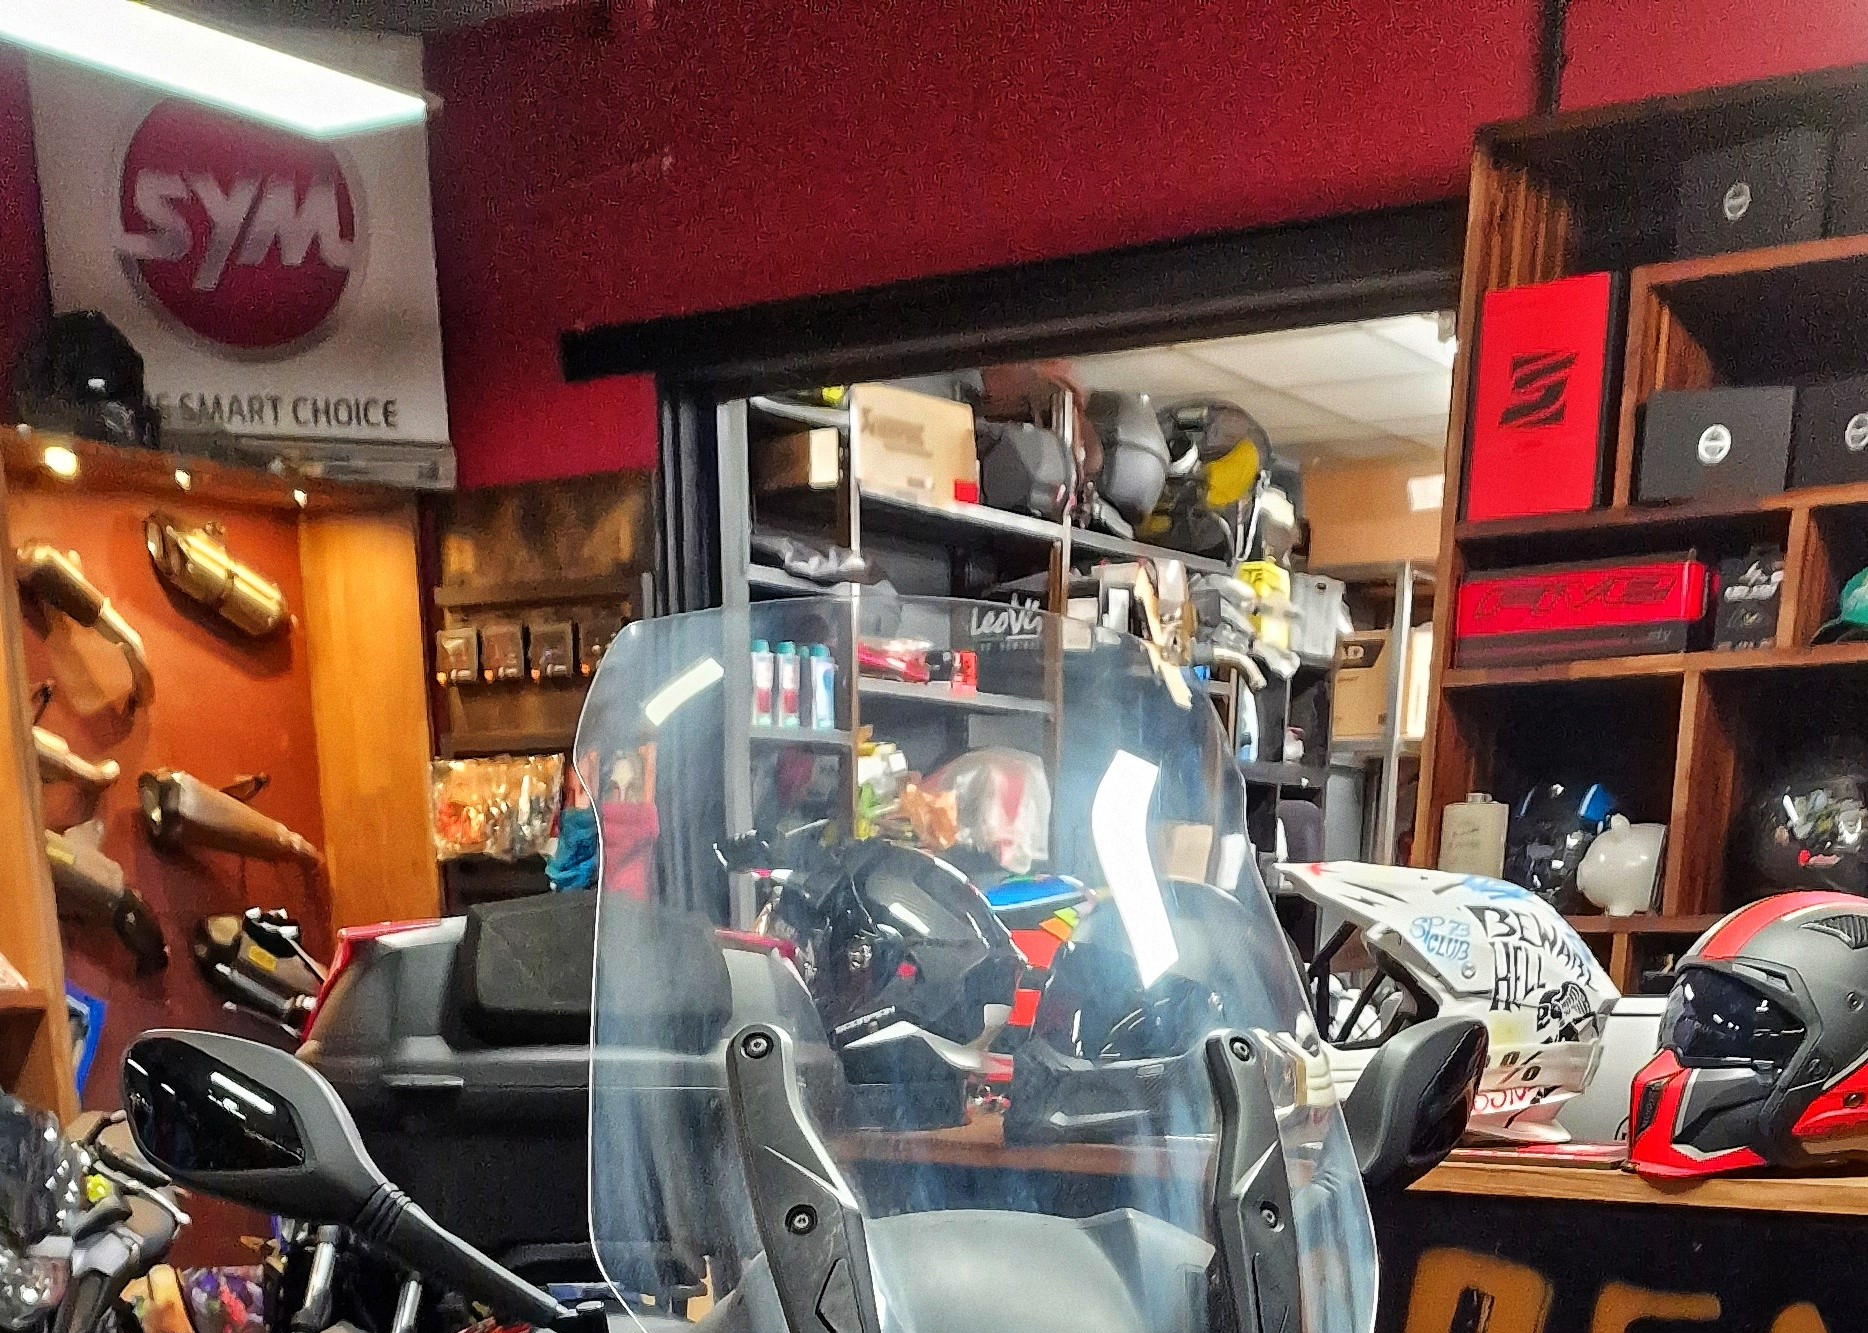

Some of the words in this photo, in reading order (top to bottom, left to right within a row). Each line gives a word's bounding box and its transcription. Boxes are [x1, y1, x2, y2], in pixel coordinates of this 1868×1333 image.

[113, 169, 357, 292] SYM
[178, 391, 281, 427] SMART
[291, 397, 398, 428] CHOICE
[1427, 933, 1471, 961] CLUB
[1488, 940, 1547, 1013] HELL
